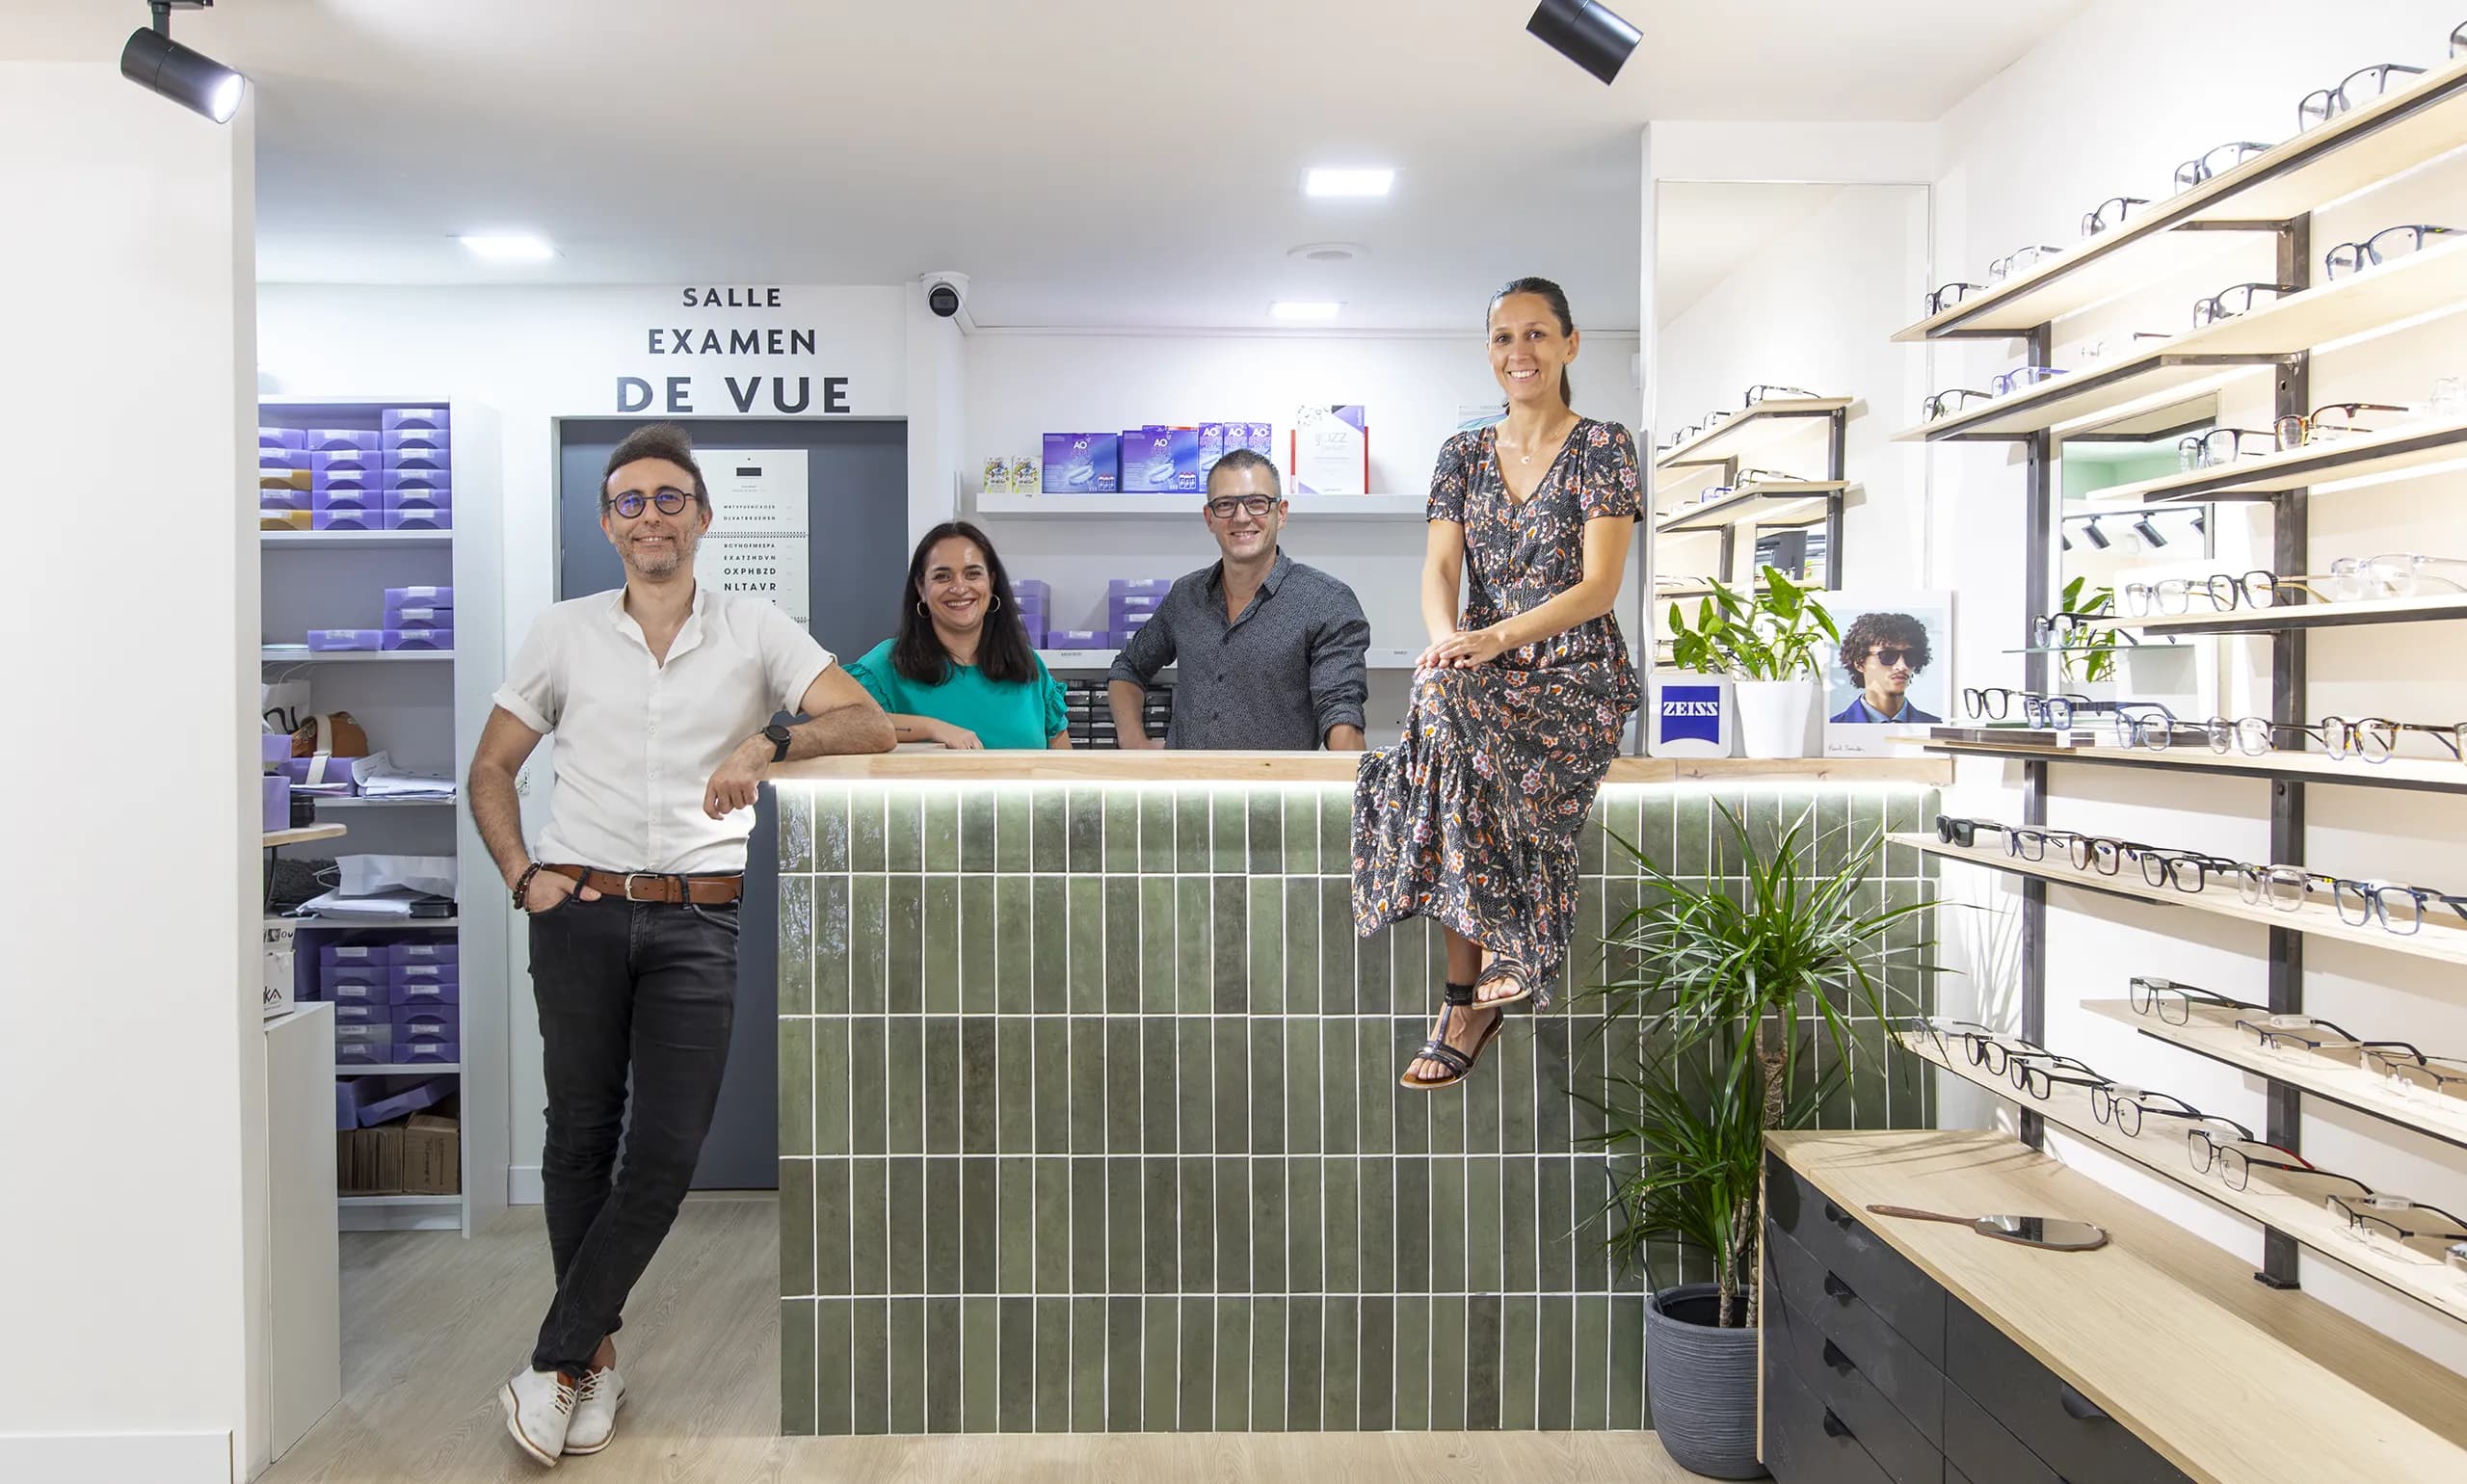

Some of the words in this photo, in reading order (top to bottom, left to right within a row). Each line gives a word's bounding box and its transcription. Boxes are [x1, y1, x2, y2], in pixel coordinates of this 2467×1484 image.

[682, 287, 782, 307] SALLE
[648, 329, 815, 355] EXAMEN
[617, 377, 694, 412] DE
[724, 377, 851, 413] VUE
[1073, 440, 1089, 450] AO
[724, 582, 777, 592] NLTAVR
[1663, 702, 1718, 716] ZEISS
